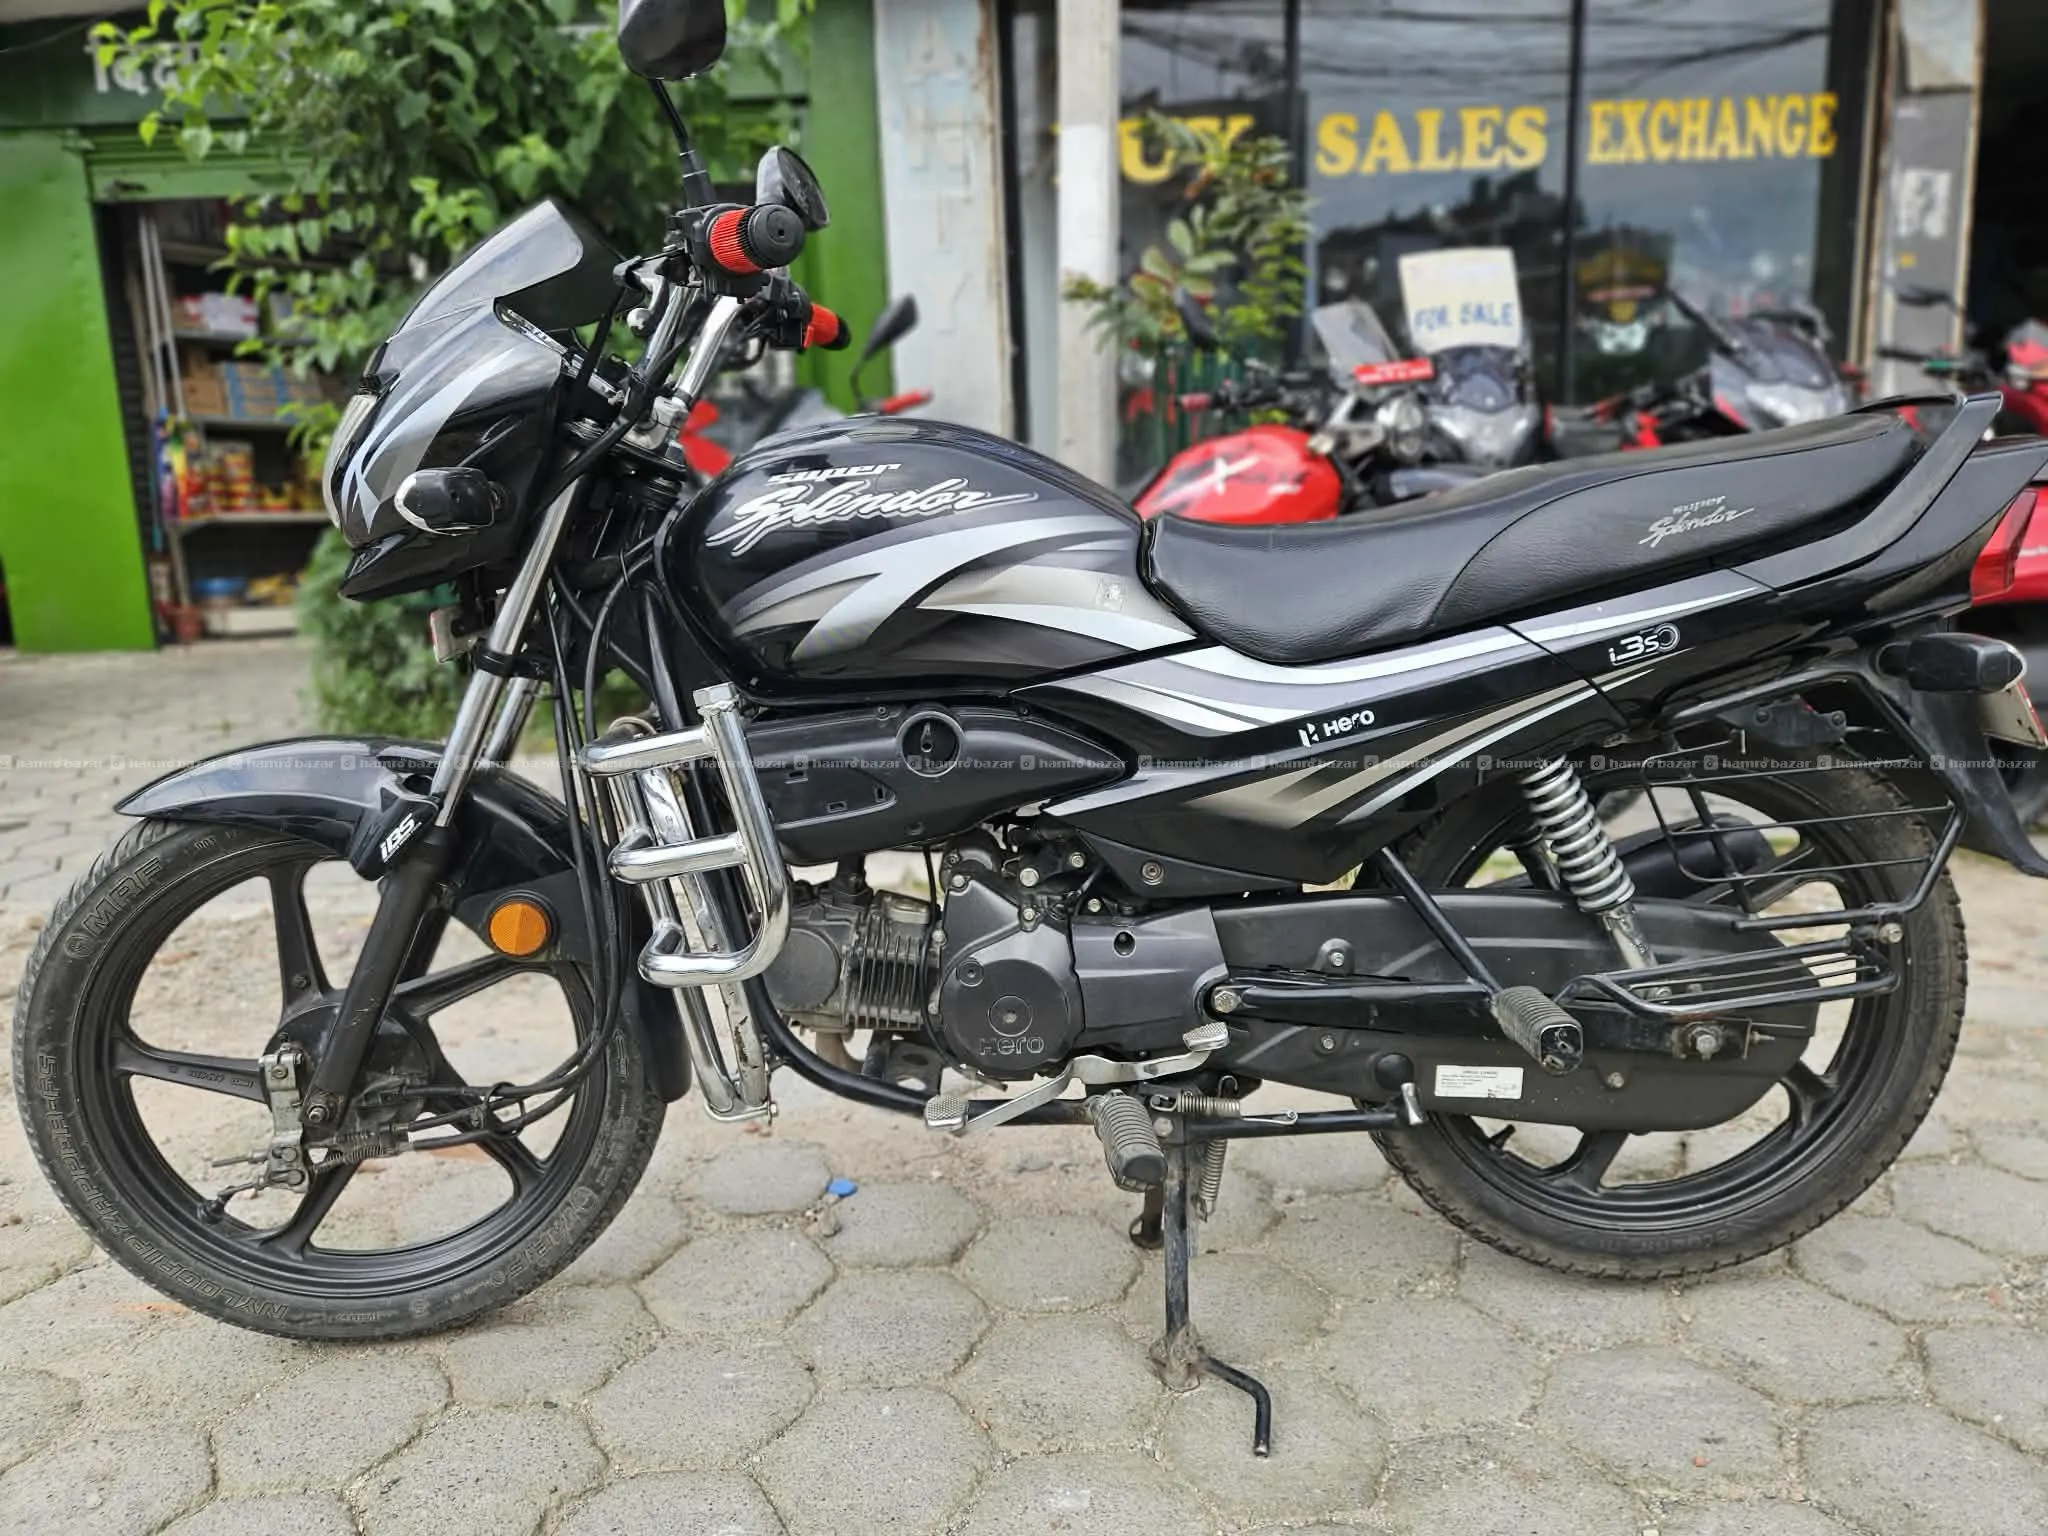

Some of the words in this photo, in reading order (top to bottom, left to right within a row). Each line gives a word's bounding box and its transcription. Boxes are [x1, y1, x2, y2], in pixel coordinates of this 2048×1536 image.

[1316, 106, 1547, 176] SALES
[1587, 93, 1838, 163] EXCHANGE
[704, 477, 1039, 557] Splendor
[1638, 506, 1755, 548] Splendor
[1322, 709, 1375, 737] Hero
[82, 856, 163, 937] MRF
